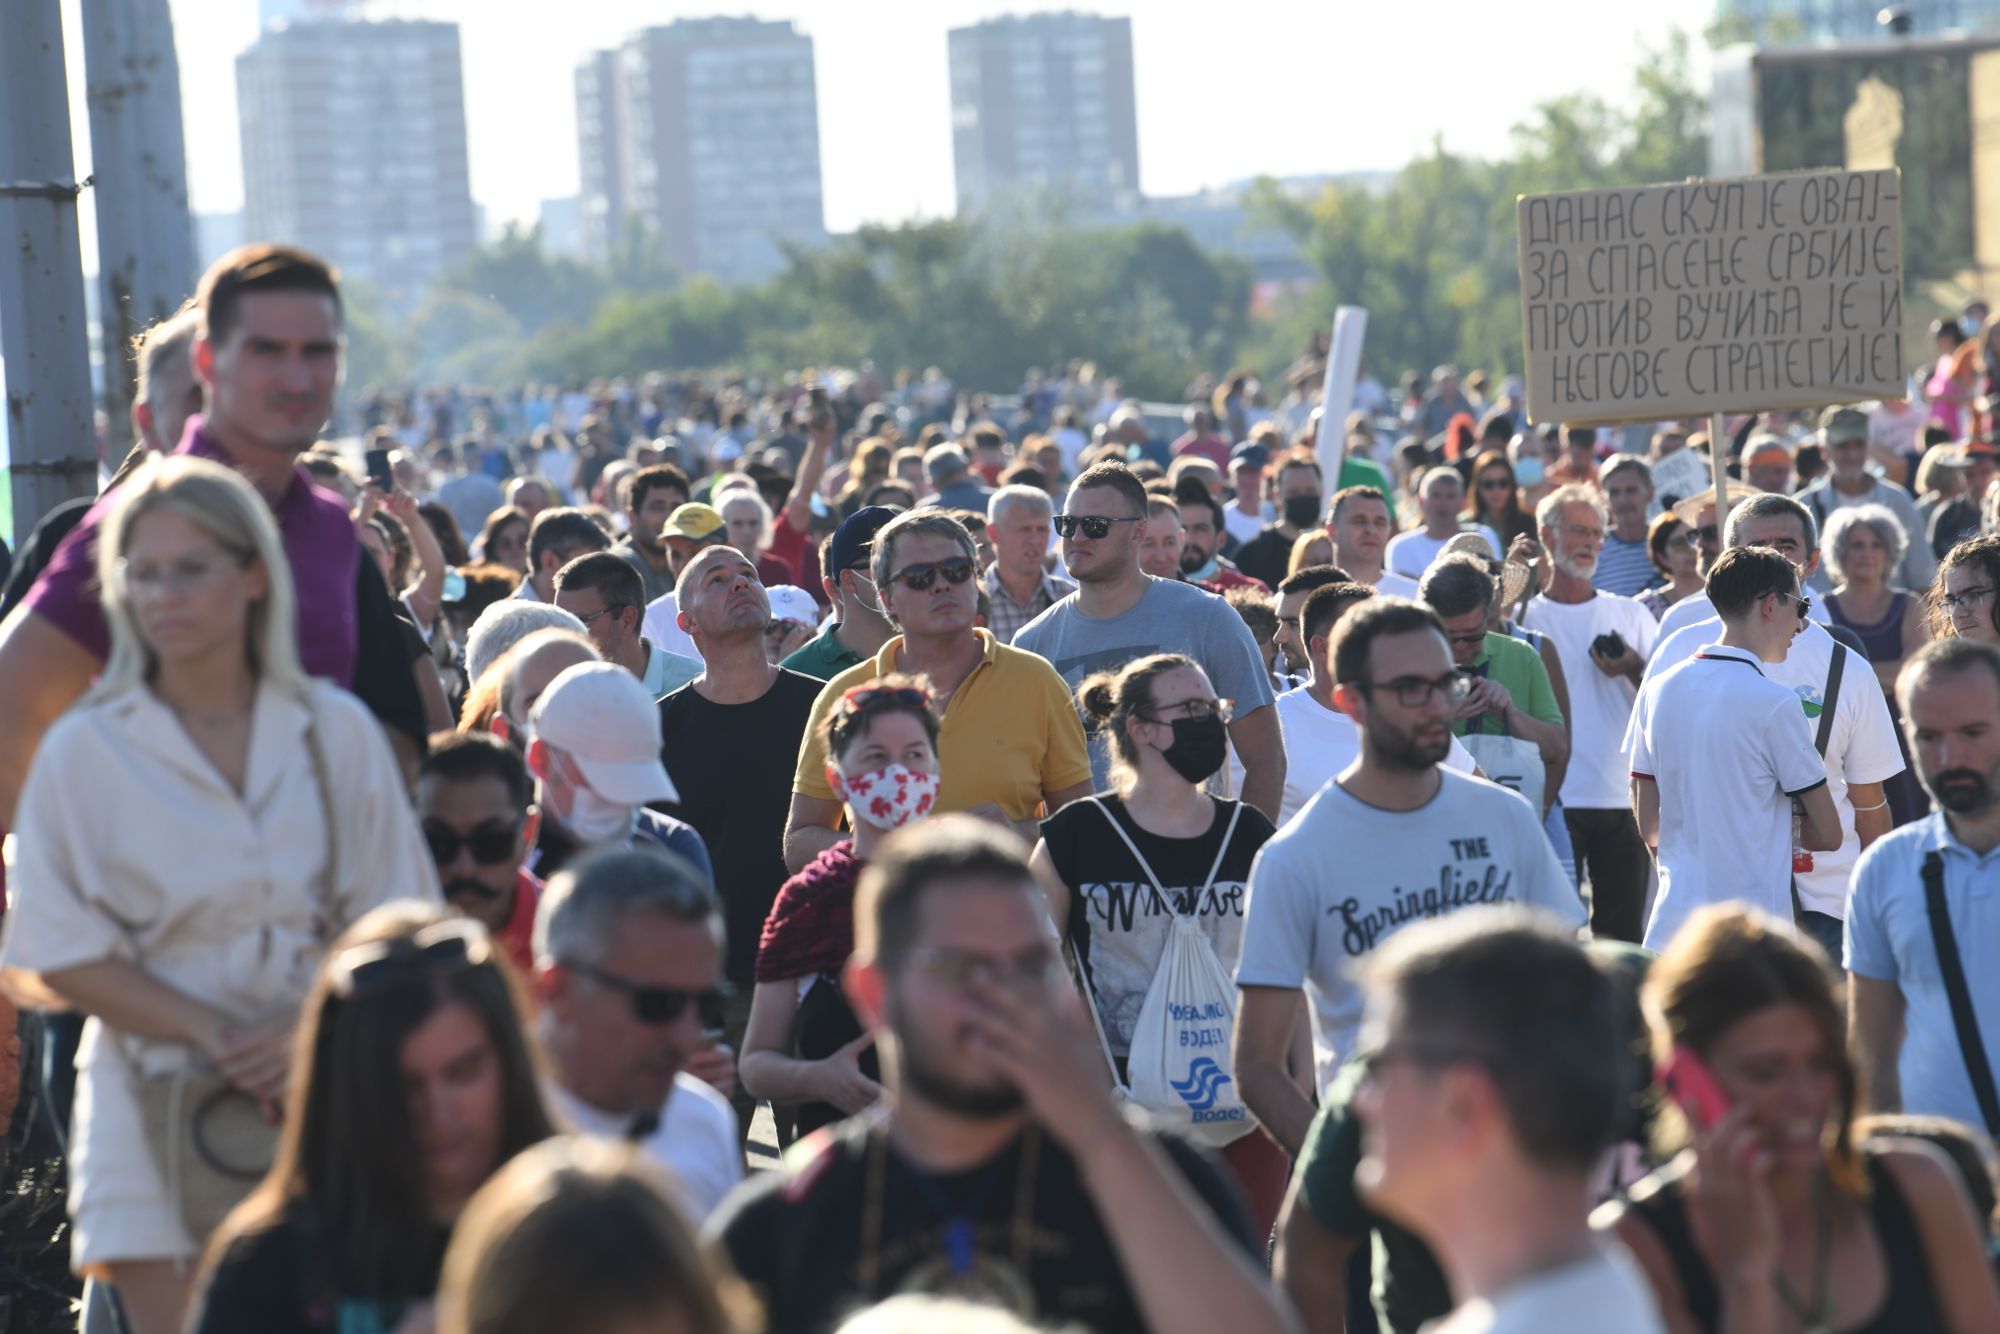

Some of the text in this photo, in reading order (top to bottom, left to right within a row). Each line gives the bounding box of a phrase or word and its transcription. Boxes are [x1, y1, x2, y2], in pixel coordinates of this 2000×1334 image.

[1528, 191, 1646, 247] ДАНАС
[1661, 183, 1745, 237] СКУП
[1756, 179, 1786, 231] ЈЕ
[1528, 249, 1569, 300] ЗА
[1587, 236, 1749, 295] СПАСЕЊЕ
[1528, 279, 1901, 351] ПРОТИВ ВУЧИЋА ЈЕ И
[1552, 333, 1901, 403] ЊЕГОВЕ СТРАТЕГИЈЕ!
[1449, 836, 1491, 861] THE
[1327, 864, 1514, 956] Springfield
